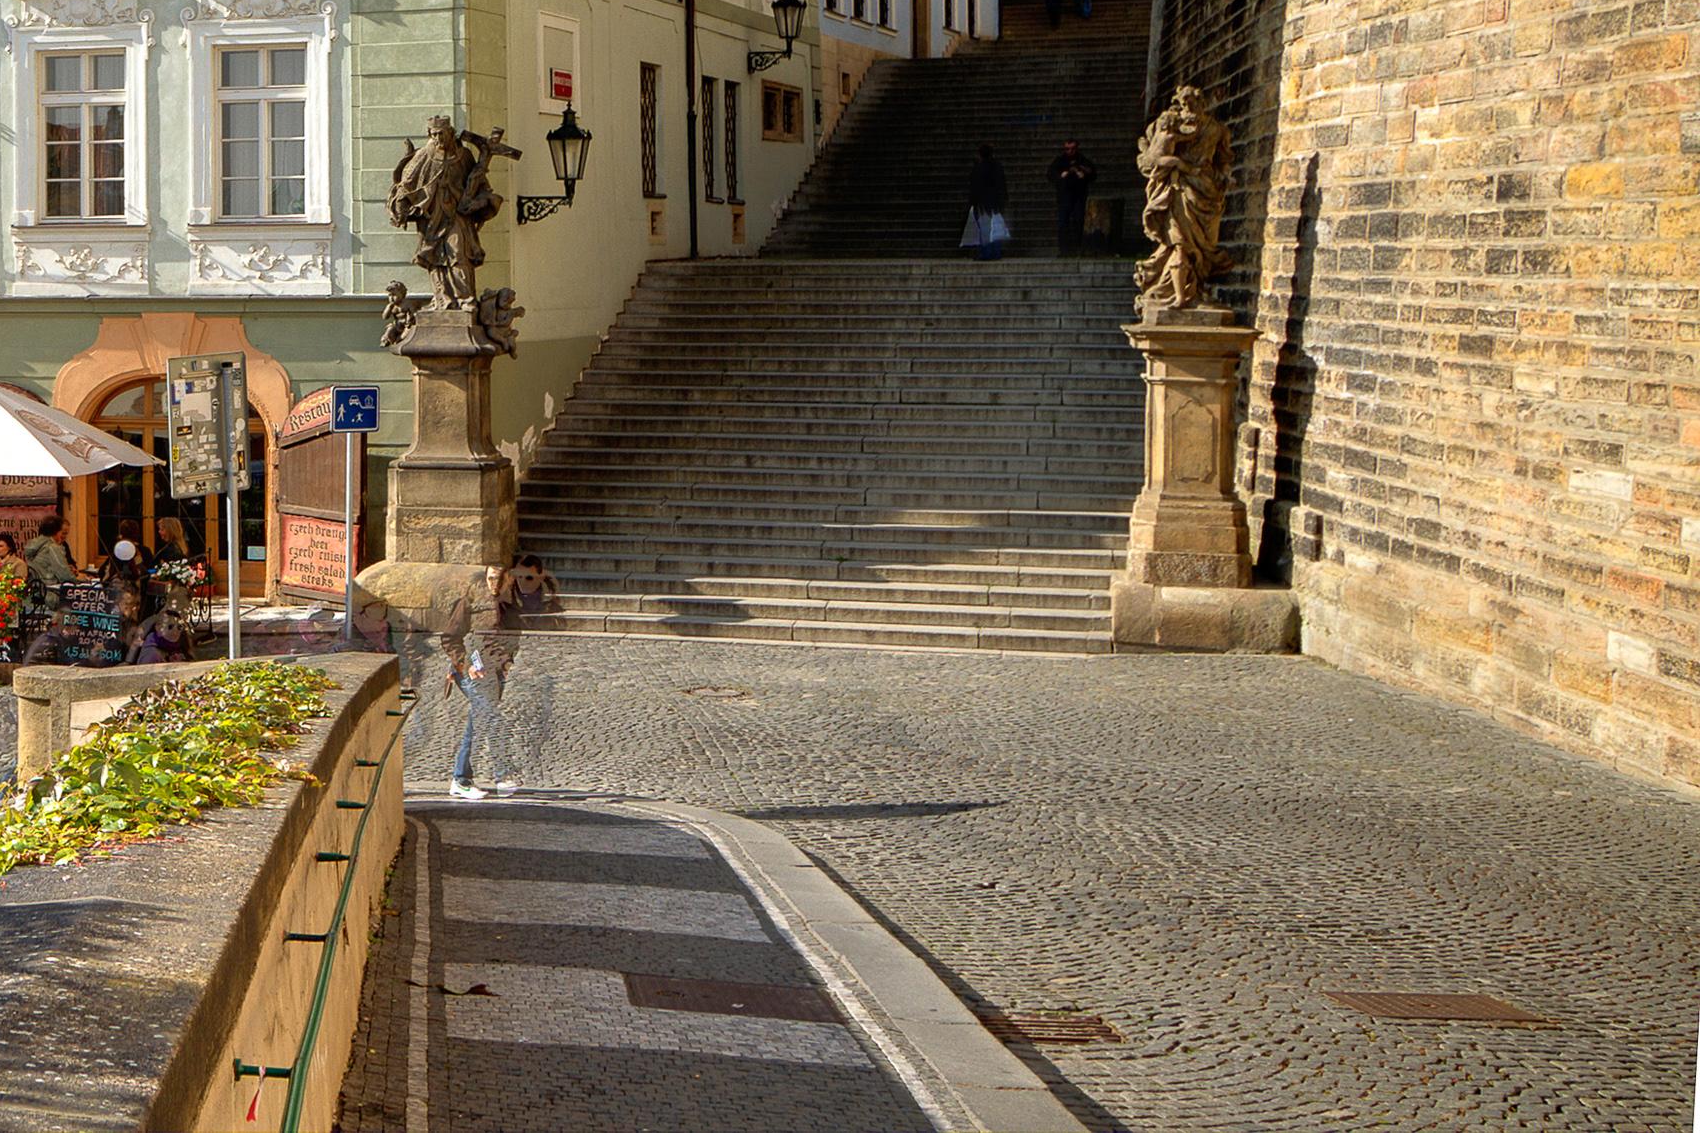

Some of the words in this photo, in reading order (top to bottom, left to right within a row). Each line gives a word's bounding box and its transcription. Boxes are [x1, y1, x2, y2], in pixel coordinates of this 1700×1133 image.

[289, 402, 332, 431] Restau
[289, 522, 314, 536] czech
[310, 537, 328, 550] beer
[289, 544, 314, 559] czech
[289, 559, 316, 574] fresh
[301, 574, 334, 588] steaks
[66, 589, 114, 604] SPECIAL
[71, 601, 107, 613] OFFER
[63, 615, 89, 627] ROSE
[92, 616, 120, 632] WINE
[87, 630, 117, 640] AFRICA
